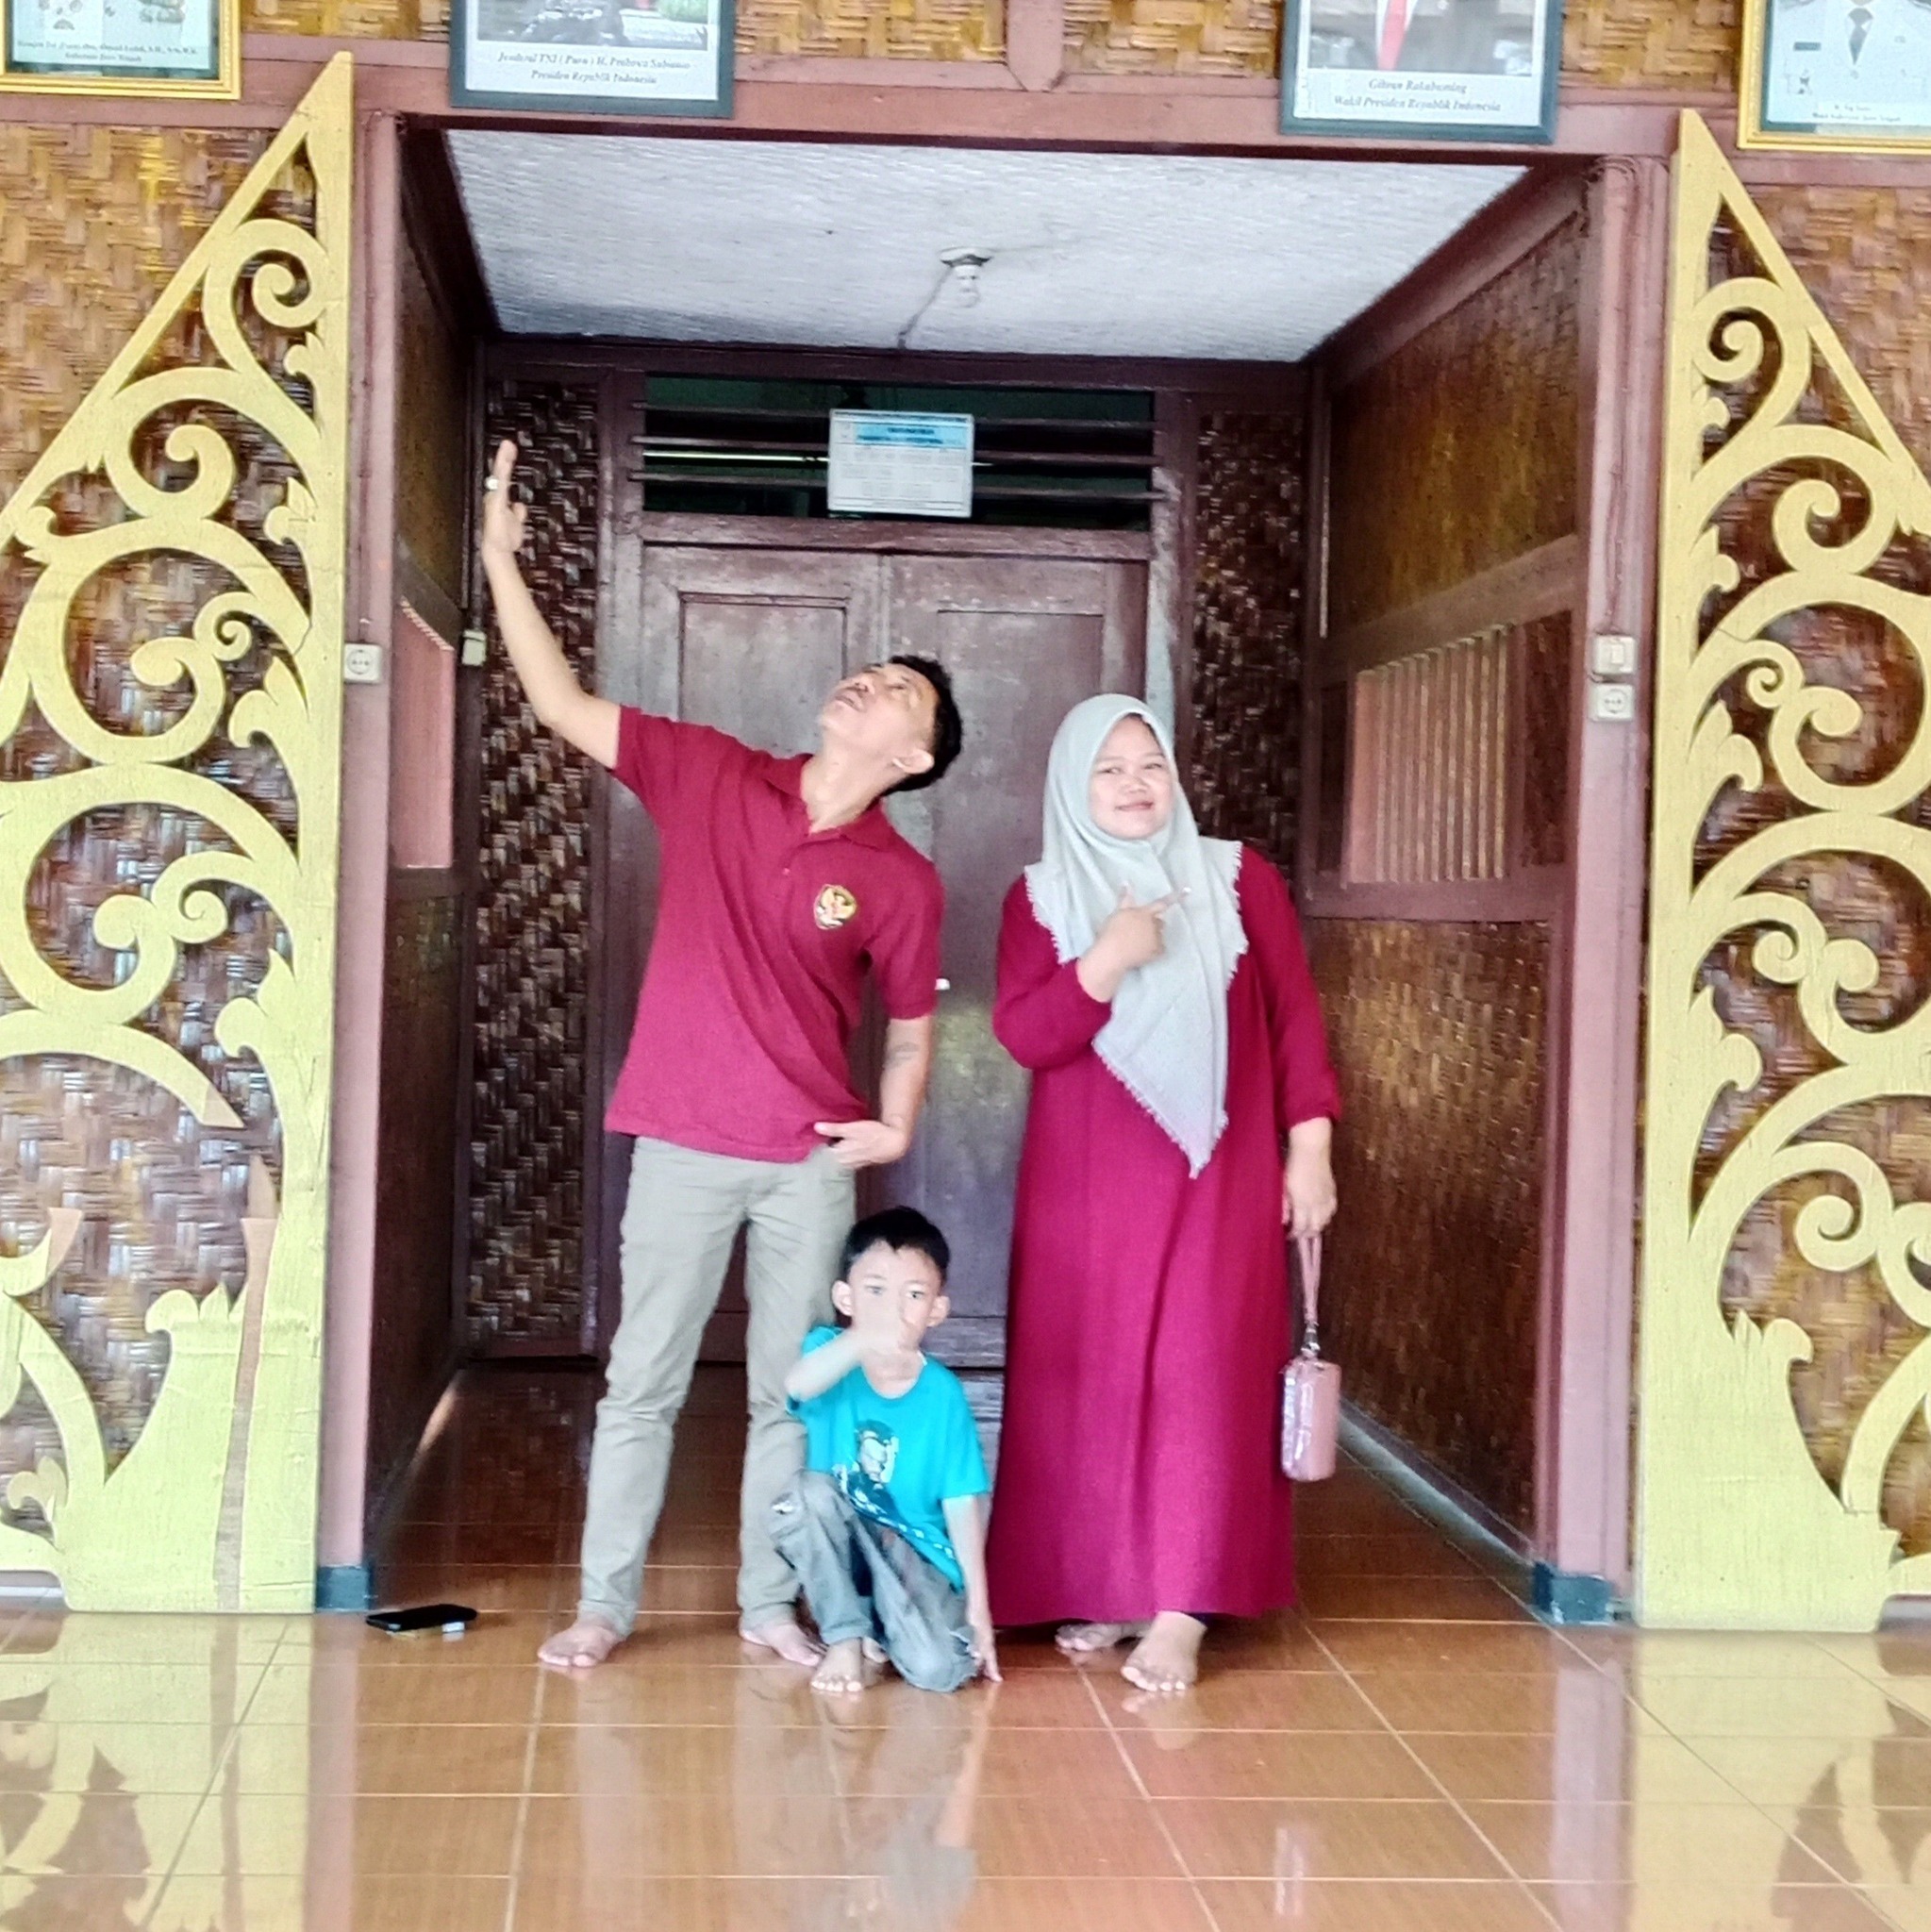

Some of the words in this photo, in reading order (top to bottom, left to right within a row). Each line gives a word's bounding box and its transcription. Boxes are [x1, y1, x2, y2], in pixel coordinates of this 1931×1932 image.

[540, 53, 558, 63] TNI
[609, 57, 649, 68] Prabowo
[530, 69, 570, 80] Presiden
[572, 71, 610, 83] Republik
[612, 73, 658, 84] Indonesia
[1334, 94, 1363, 107] Wakil
[1363, 96, 1406, 108] Presiden
[1407, 98, 1452, 112] Republik
[1453, 99, 1502, 112] Indonesia
